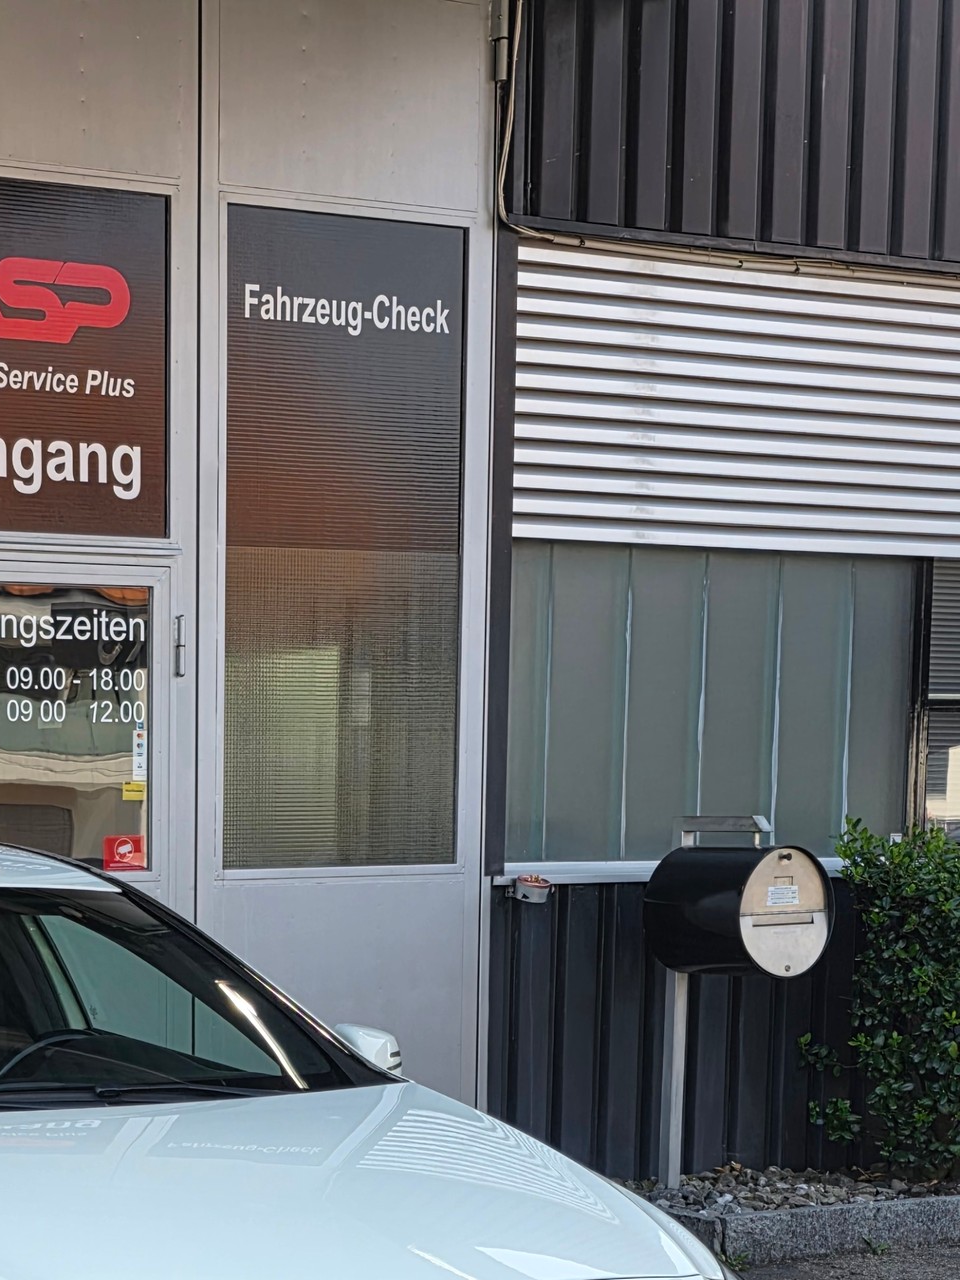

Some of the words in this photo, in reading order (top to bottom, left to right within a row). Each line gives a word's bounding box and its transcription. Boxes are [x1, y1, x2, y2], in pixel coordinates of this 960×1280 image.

[243, 283, 450, 336] Fahrzeug-Check
[85, 369, 135, 398] Plus
[6, 666, 66, 690] 09.00
[88, 668, 145, 691] 18.00
[90, 700, 145, 723] 12.00
